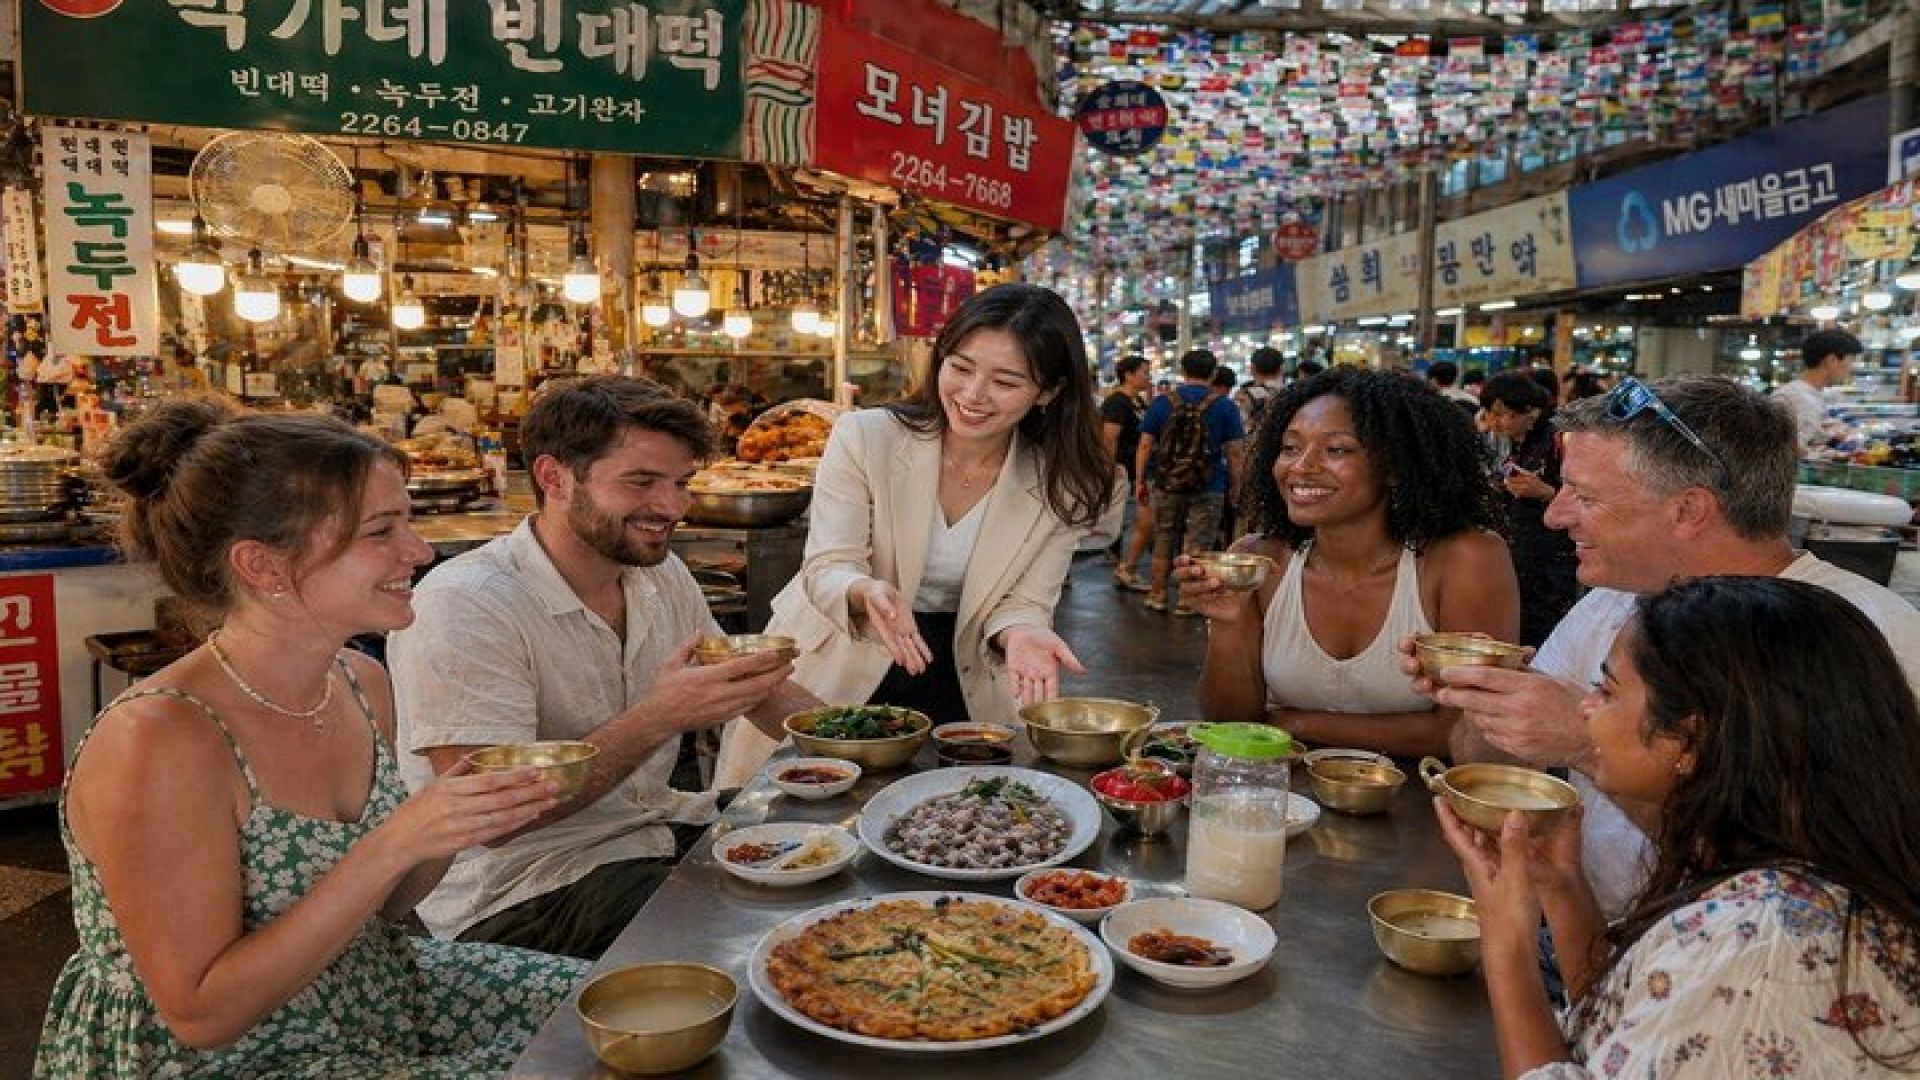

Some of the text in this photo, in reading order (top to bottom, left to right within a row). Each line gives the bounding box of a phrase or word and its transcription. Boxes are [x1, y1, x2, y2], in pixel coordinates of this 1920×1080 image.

[488, 0, 724, 90] 빈대떡
[231, 67, 646, 124] 빈대떡 녹두전 고기완자
[340, 112, 529, 142] 2264-0847
[856, 62, 1038, 172] 모녀김밥
[891, 150, 1012, 208] 2264-7668
[63, 181, 137, 347] 녹두전
